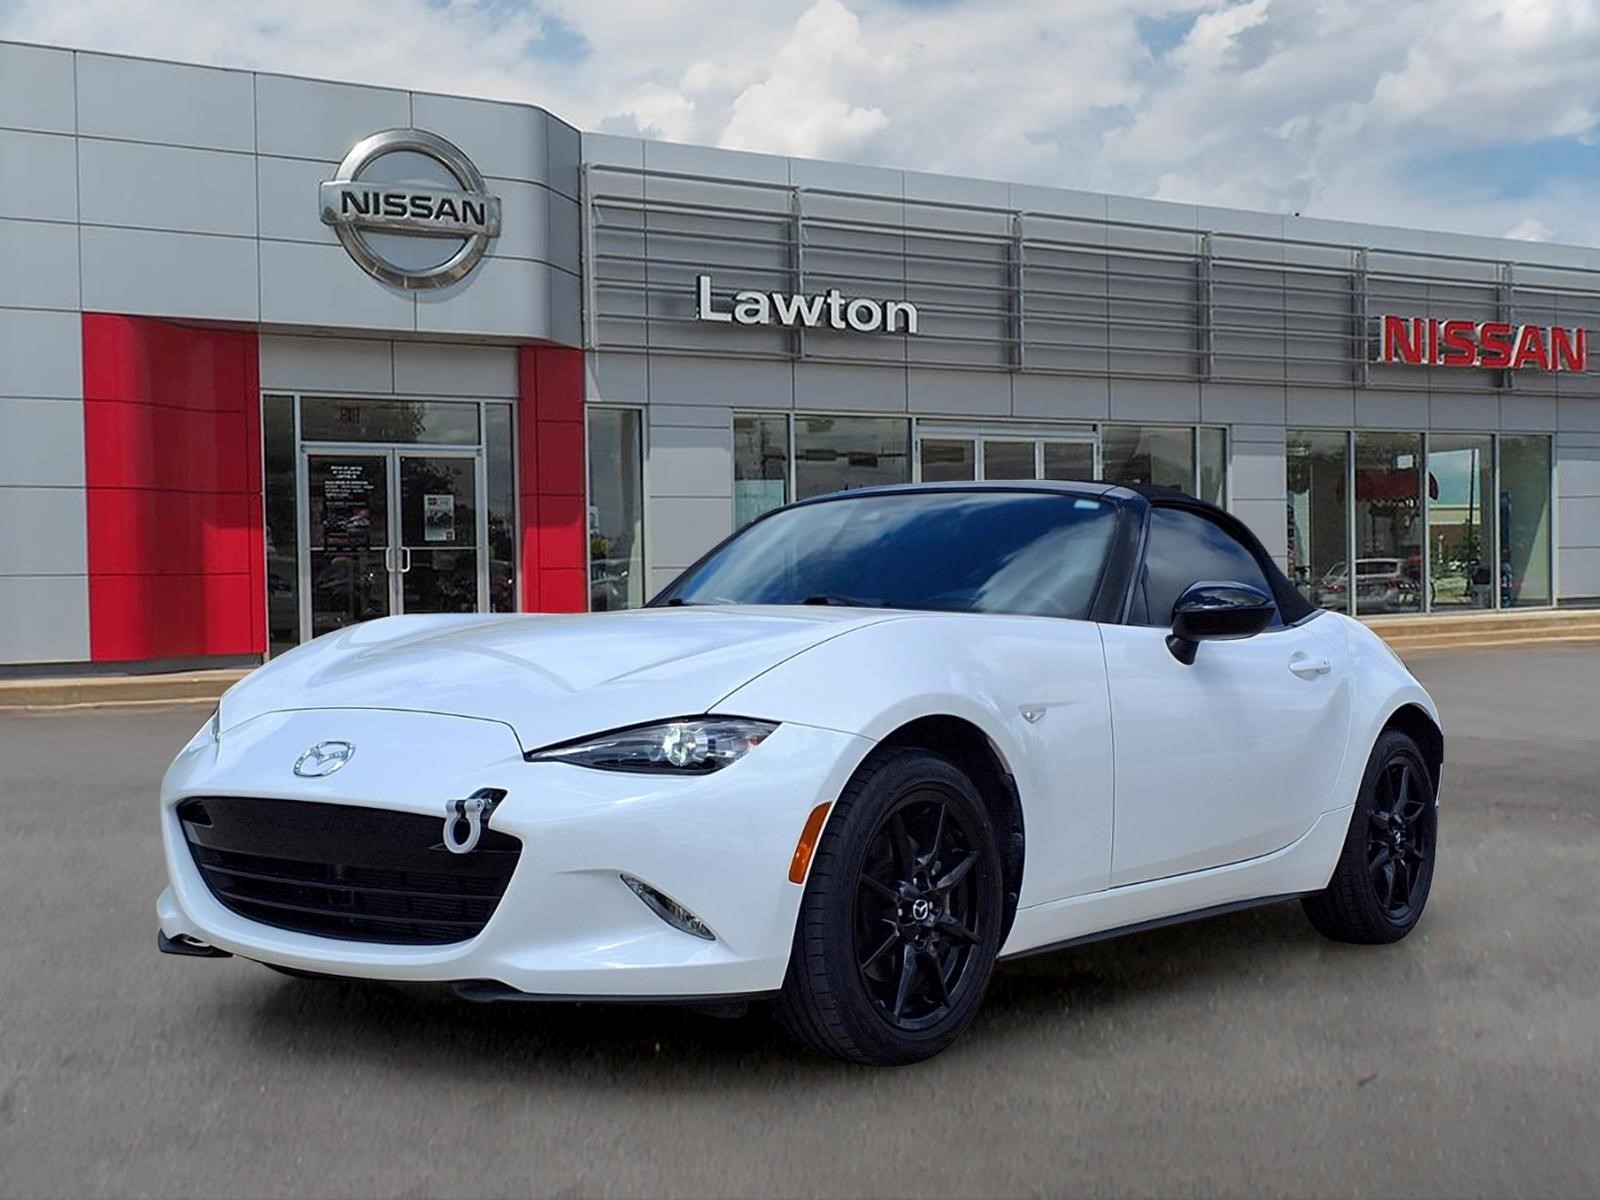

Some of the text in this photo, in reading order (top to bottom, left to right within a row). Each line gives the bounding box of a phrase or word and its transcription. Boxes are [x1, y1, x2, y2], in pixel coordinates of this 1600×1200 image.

[341, 190, 486, 226] NISSAN
[697, 274, 919, 334] Lawton
[1381, 314, 1588, 374] NISSAN
